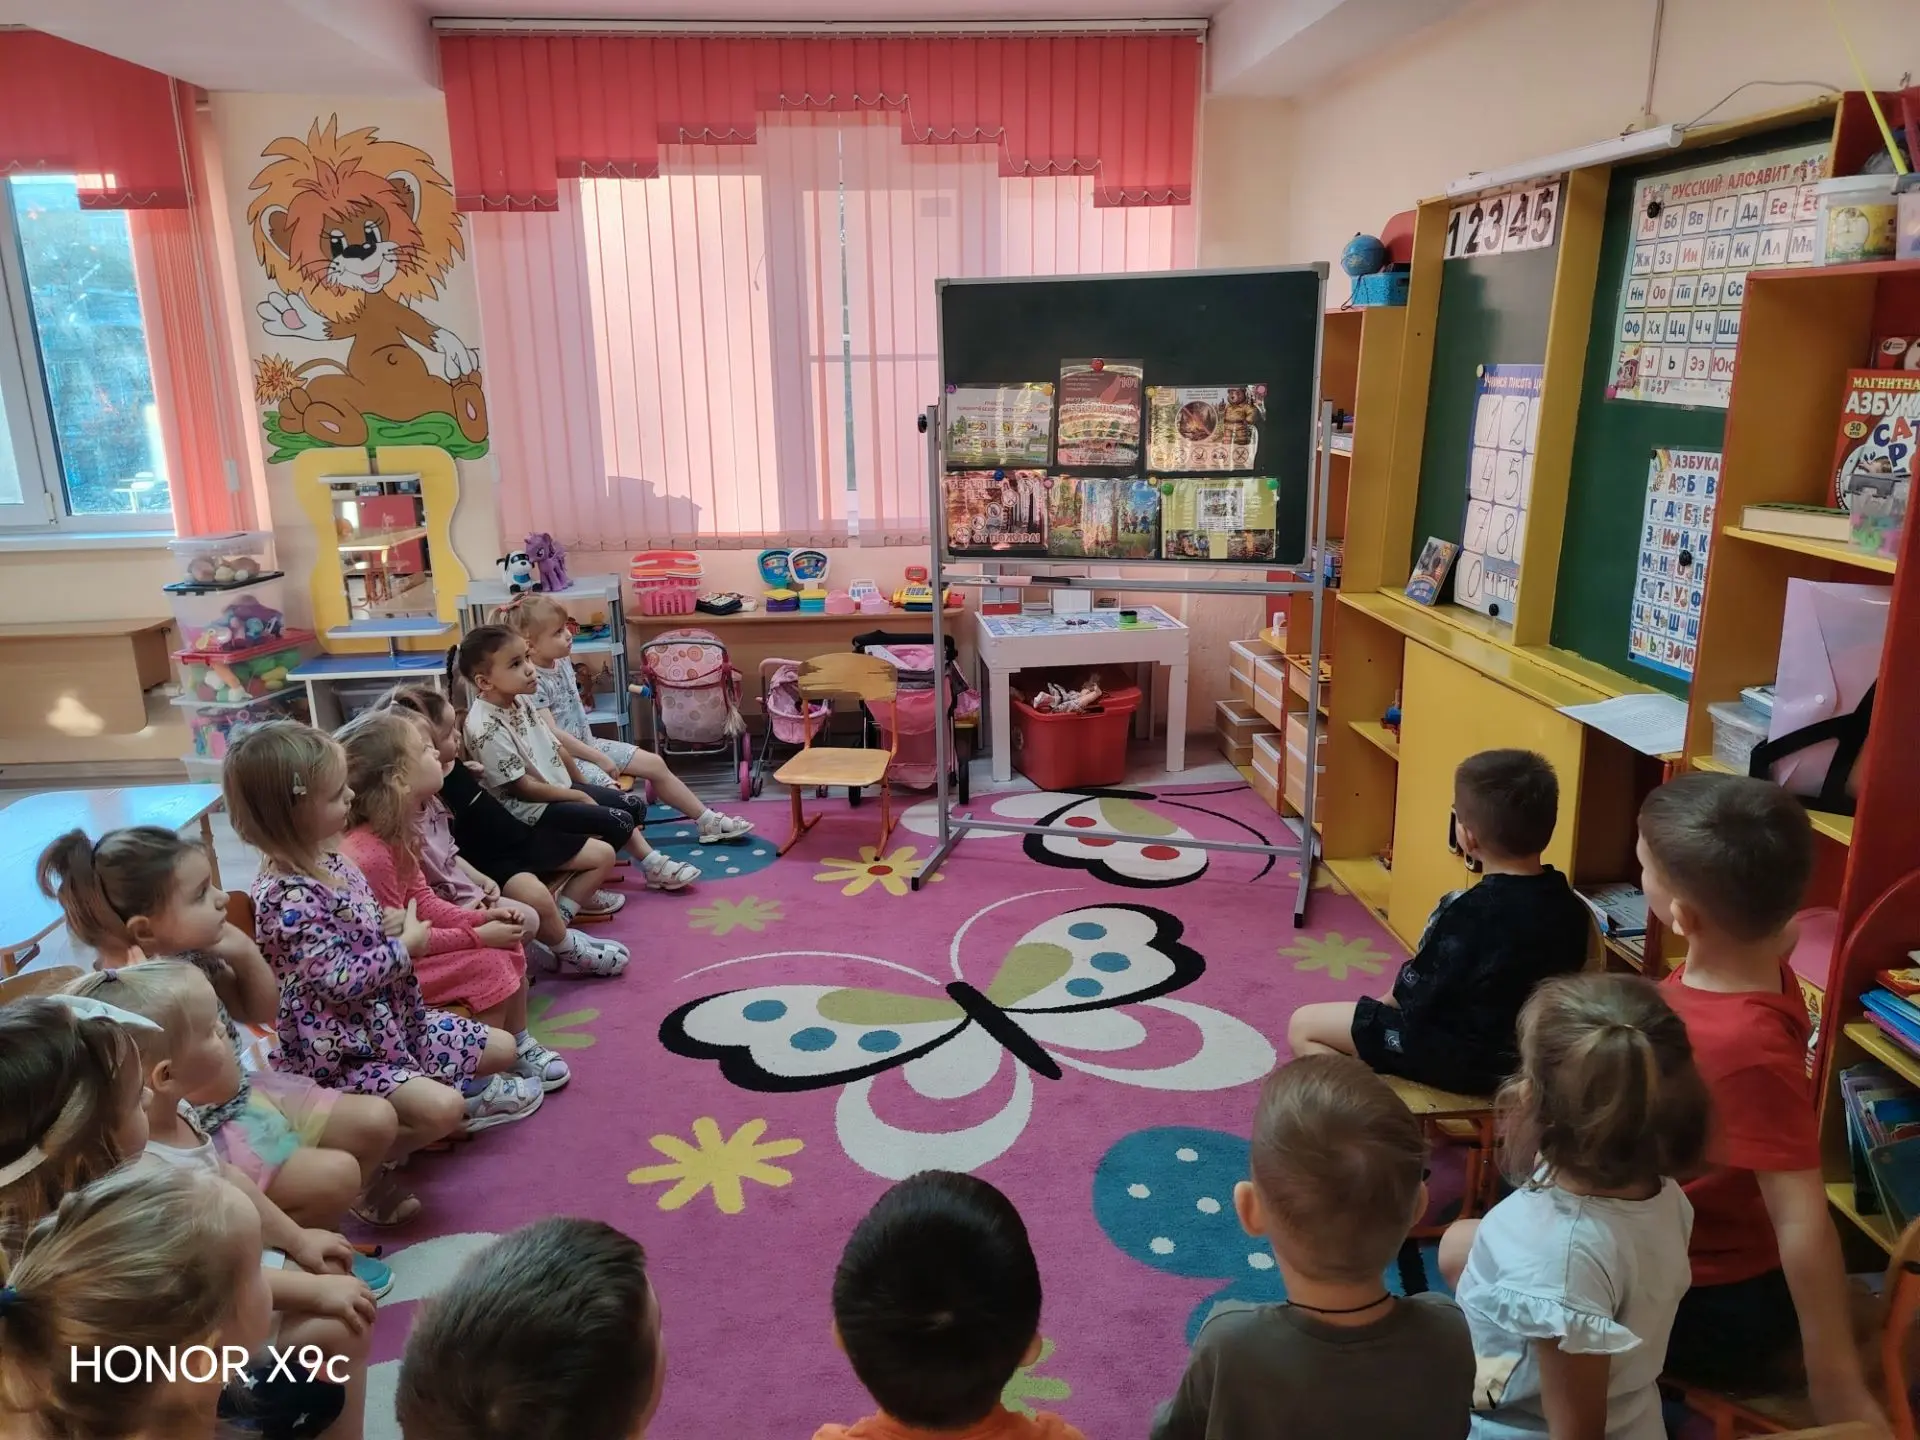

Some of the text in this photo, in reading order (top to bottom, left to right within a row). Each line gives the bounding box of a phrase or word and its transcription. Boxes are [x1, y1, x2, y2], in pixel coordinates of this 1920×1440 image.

[1671, 163, 1791, 200] РУССКИЙ АЛФАВИТ
[1448, 188, 1553, 256] 1 2 3 4 5
[1664, 212, 1678, 229] Бб
[1688, 210, 1703, 226] Вв
[1714, 206, 1729, 223] Гг
[1740, 204, 1758, 221] Дд
[1770, 198, 1788, 215] Ее
[1635, 250, 1650, 267] Жж
[1658, 248, 1672, 265] Зз
[1707, 241, 1724, 261] Йй
[1735, 242, 1751, 258] Кк
[1761, 239, 1781, 256] Лл
[1630, 281, 1743, 301] Нн Оо Пп Рр Сс
[1624, 320, 1640, 336] Фф
[1647, 320, 1660, 334] Хх
[1669, 320, 1686, 337] Цц
[1695, 320, 1711, 334] Чч
[1690, 356, 1705, 371] Ээ
[1509, 401, 1526, 446] 2
[1850, 423, 1861, 431] 50
[1674, 454, 1719, 472] АЗБУКА
[1504, 458, 1521, 500] 5
[1668, 473, 1716, 495] А Б В
[1650, 499, 1657, 516] Г
[1665, 501, 1675, 518] Д
[1684, 503, 1693, 521] Е
[973, 532, 1041, 543] ОТ ПОЖАРА!
[1497, 513, 1515, 554] 8
[1645, 525, 1654, 542] З
[1681, 530, 1690, 549] Й
[1699, 534, 1708, 552] К
[1642, 551, 1652, 568] М
[1659, 555, 1668, 572] Н
[1695, 562, 1704, 580] П
[1641, 578, 1701, 608] С Т У Ф
[1653, 609, 1661, 626] Ч
[1668, 613, 1680, 632] Ш
